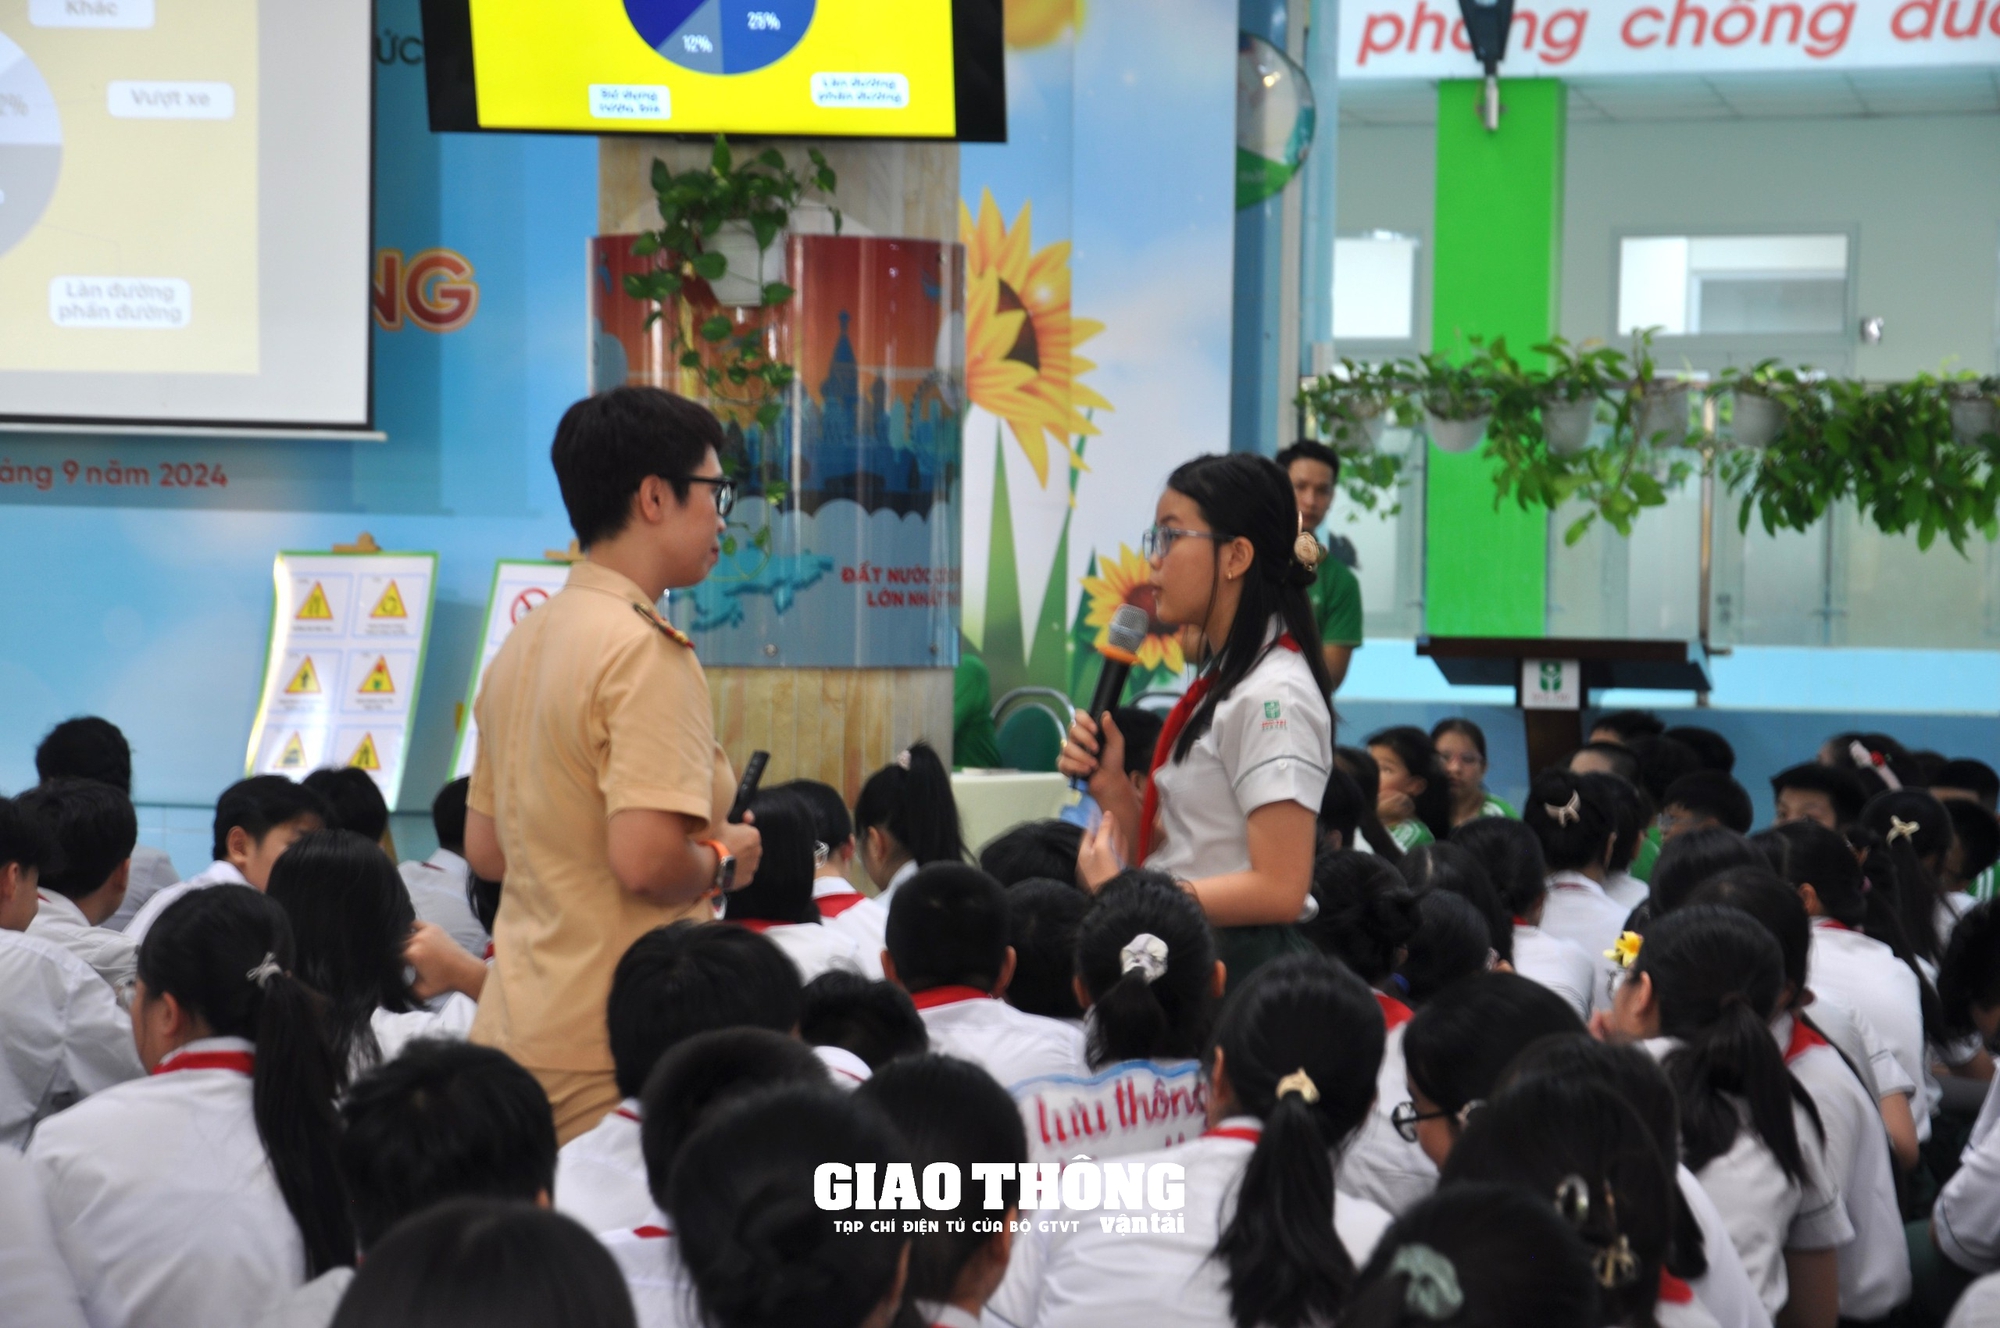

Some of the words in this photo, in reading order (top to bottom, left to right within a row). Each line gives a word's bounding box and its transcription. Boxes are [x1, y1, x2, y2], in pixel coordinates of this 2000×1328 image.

[61, 459, 79, 484] 9
[86, 459, 149, 485] năm
[159, 462, 228, 488] 2024
